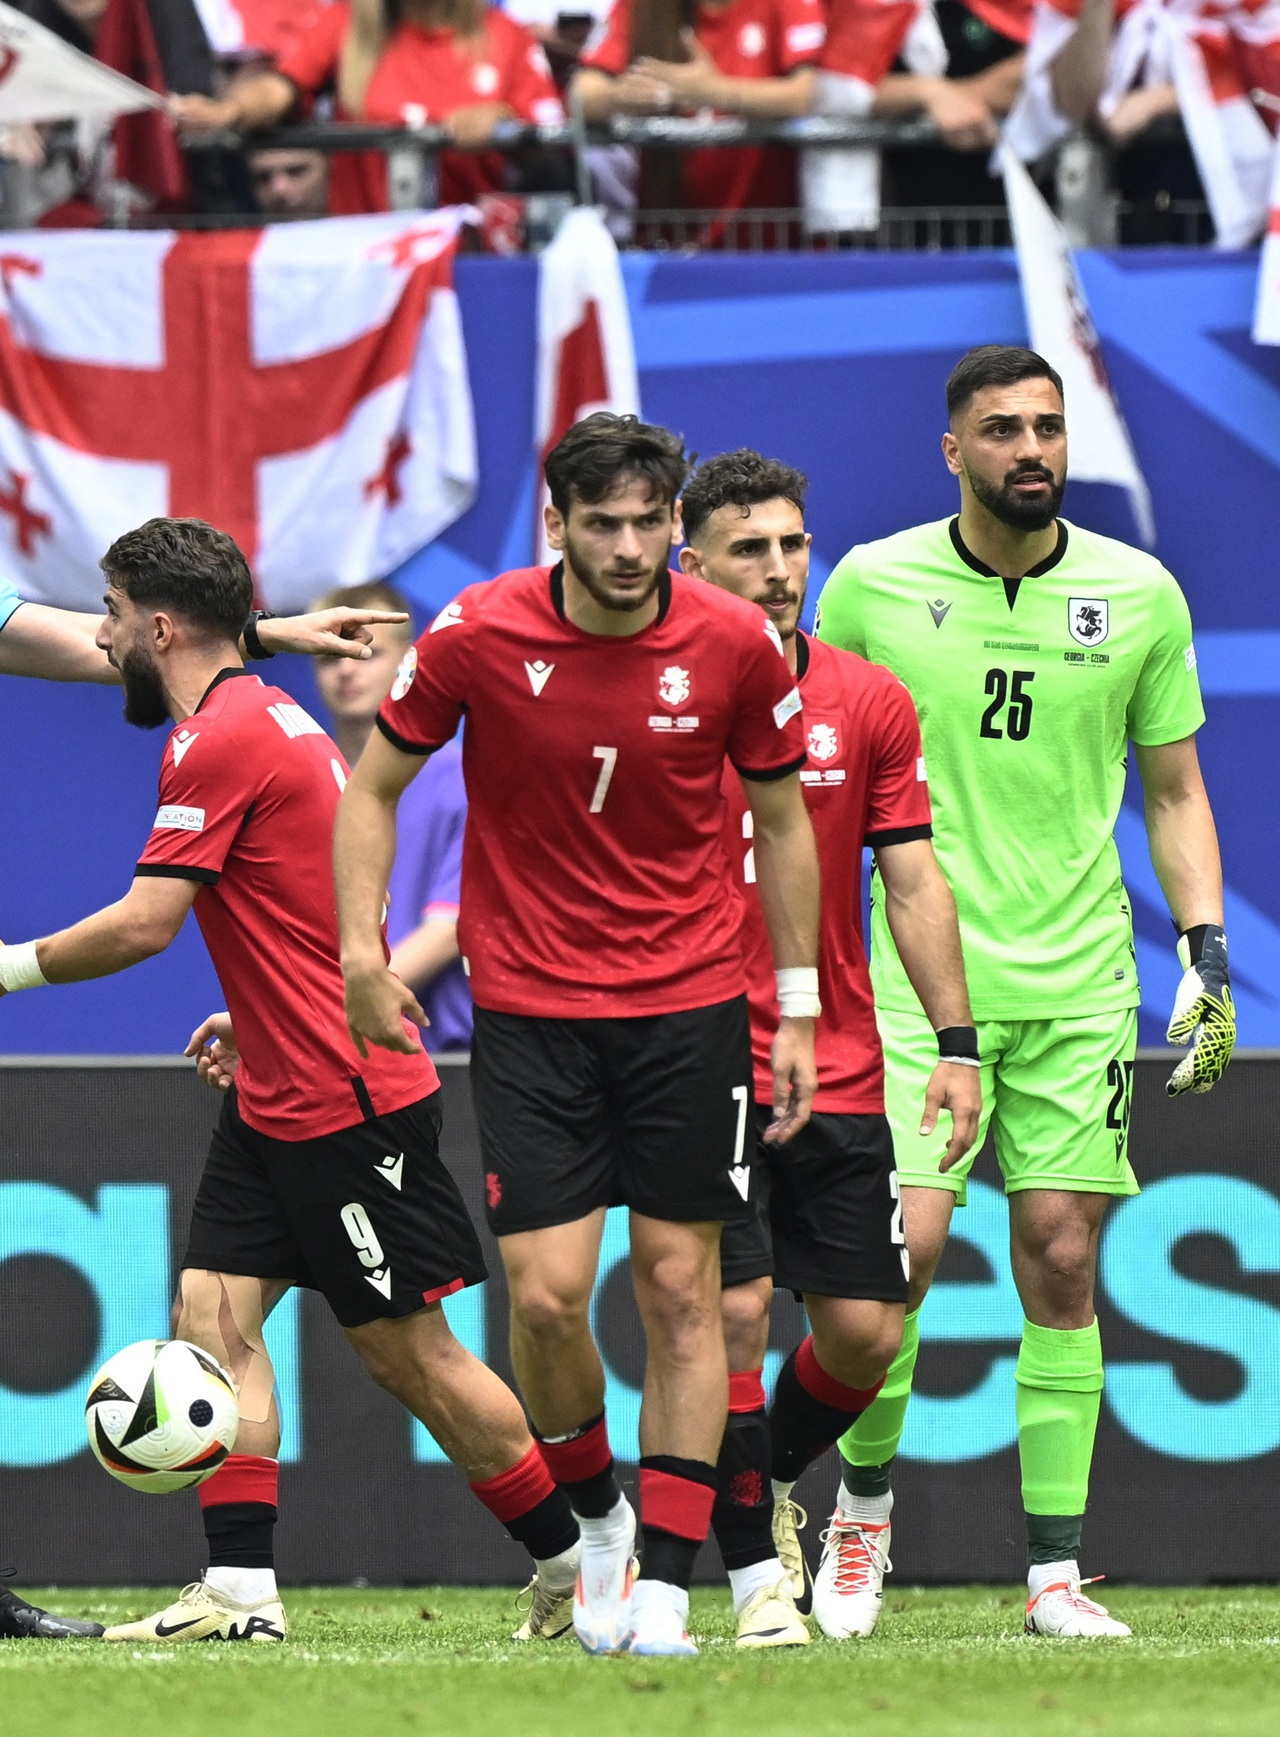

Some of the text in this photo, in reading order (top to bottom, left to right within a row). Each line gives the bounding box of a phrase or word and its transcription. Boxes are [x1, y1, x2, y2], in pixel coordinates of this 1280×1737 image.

[979, 667, 1036, 741] 25
[589, 745, 618, 814] 7
[340, 1202, 385, 1269] 9
